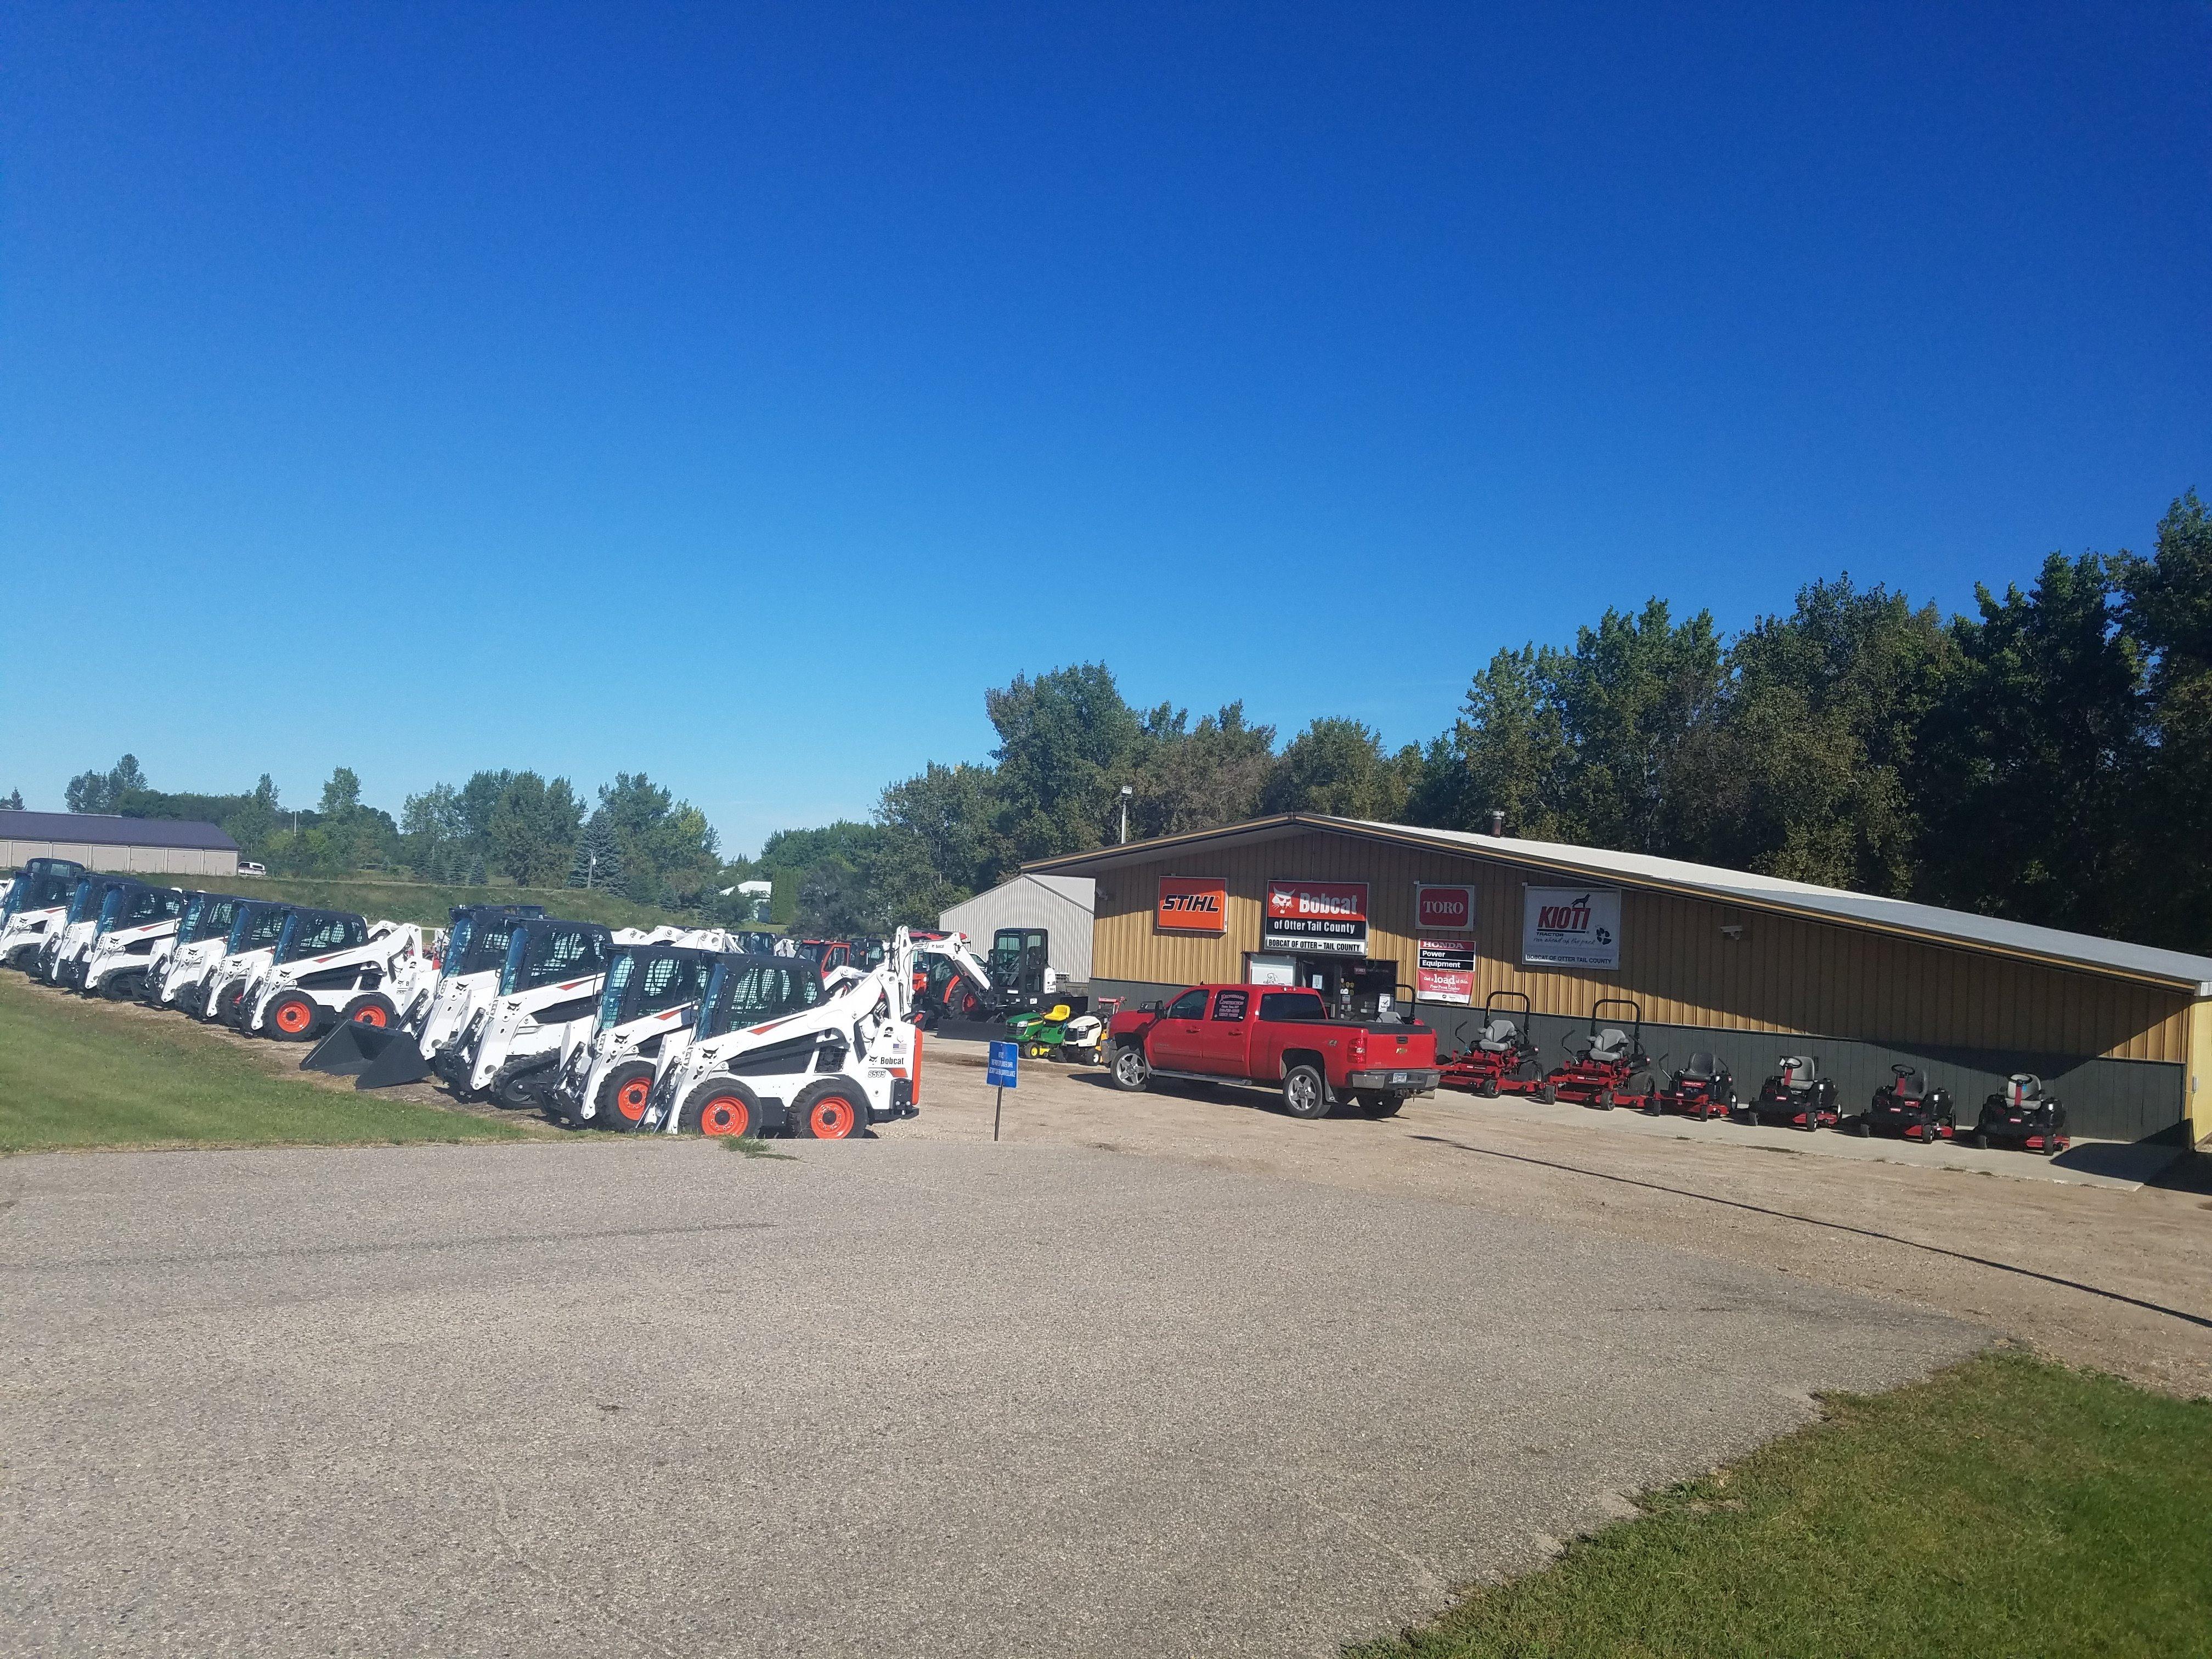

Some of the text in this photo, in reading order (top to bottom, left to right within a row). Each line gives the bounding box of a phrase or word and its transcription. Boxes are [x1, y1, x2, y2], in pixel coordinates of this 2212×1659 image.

[1161, 894, 1220, 912] STIHL
[1299, 893, 1357, 915] Bobcat
[1423, 901, 1464, 914] TORO
[1538, 906, 1591, 929] KIOTI
[1274, 920, 1355, 934] of Otter Tail County
[1337, 943, 1360, 952] COUNTY
[1422, 960, 1460, 968] Equipment
[1434, 974, 1455, 985] load
[880, 1057, 904, 1065] Bobcat
